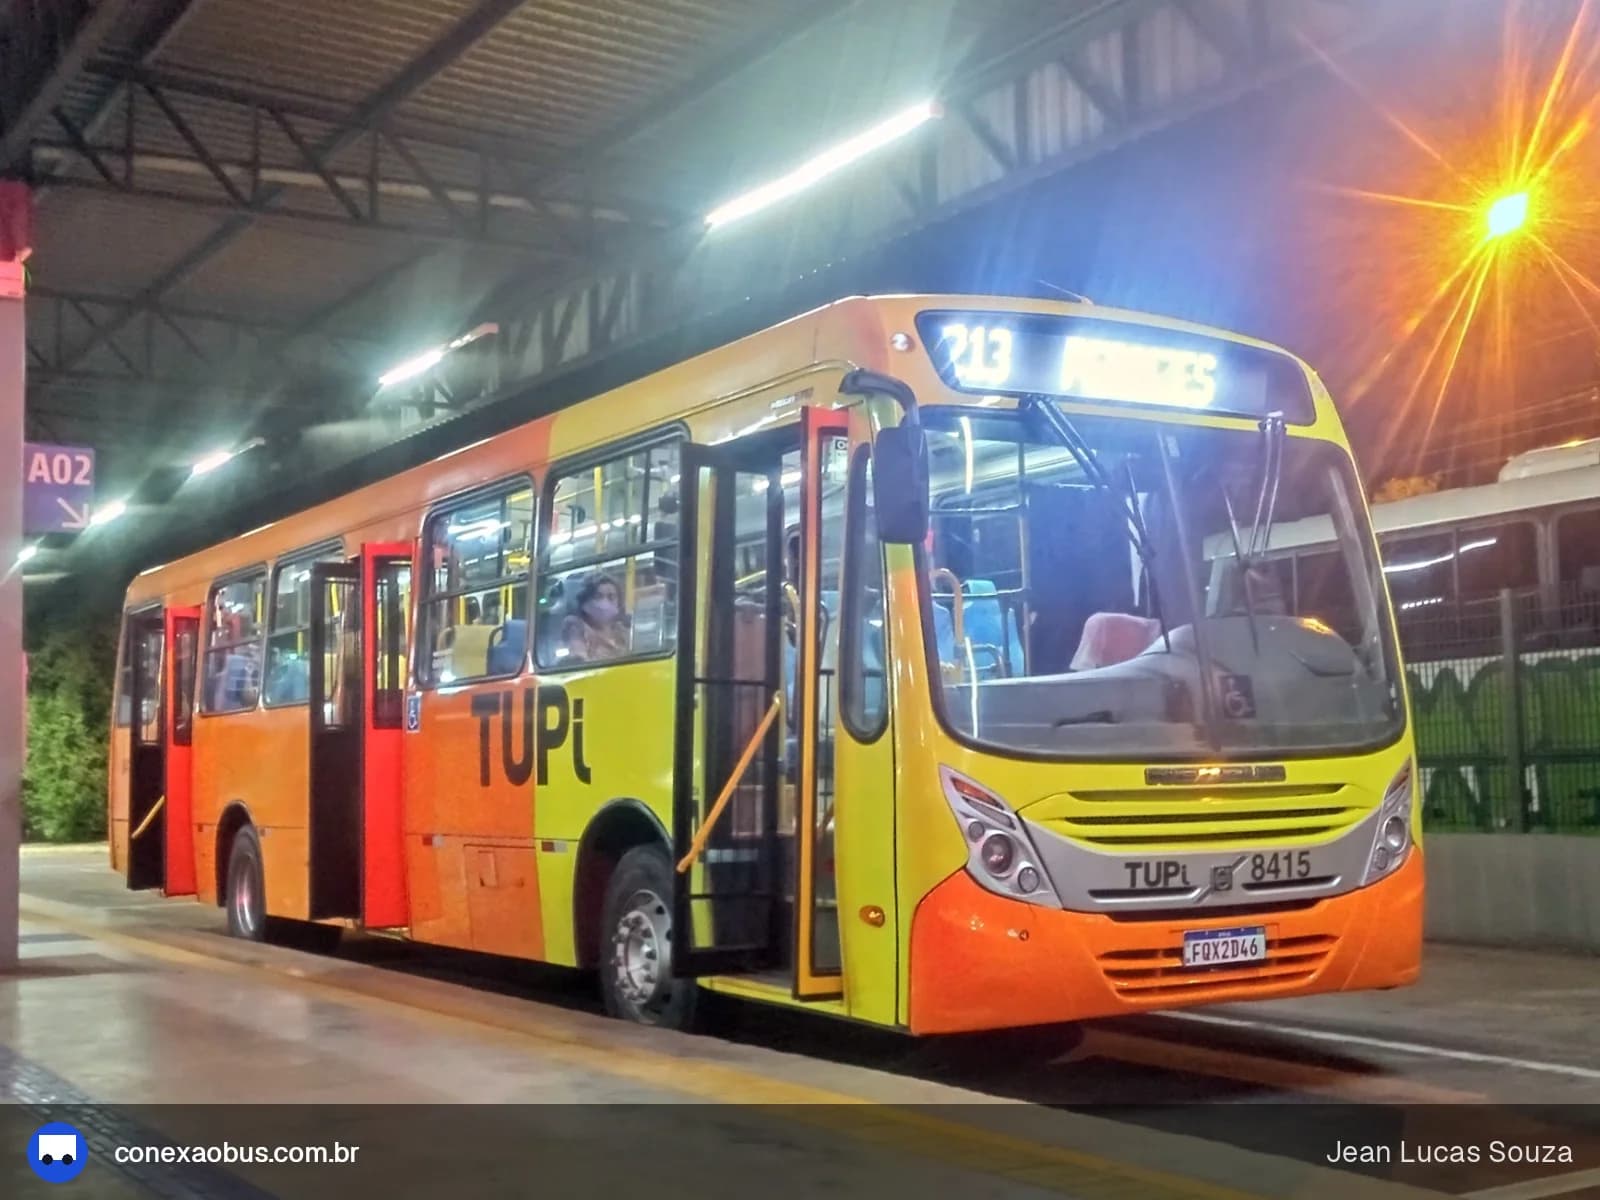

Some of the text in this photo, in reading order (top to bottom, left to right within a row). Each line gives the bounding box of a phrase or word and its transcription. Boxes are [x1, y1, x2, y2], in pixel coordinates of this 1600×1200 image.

[943, 324, 1012, 385] 213
[27, 452, 92, 485] A02
[1250, 850, 1312, 882] 8415
[1191, 937, 1259, 963] FQX2D46
